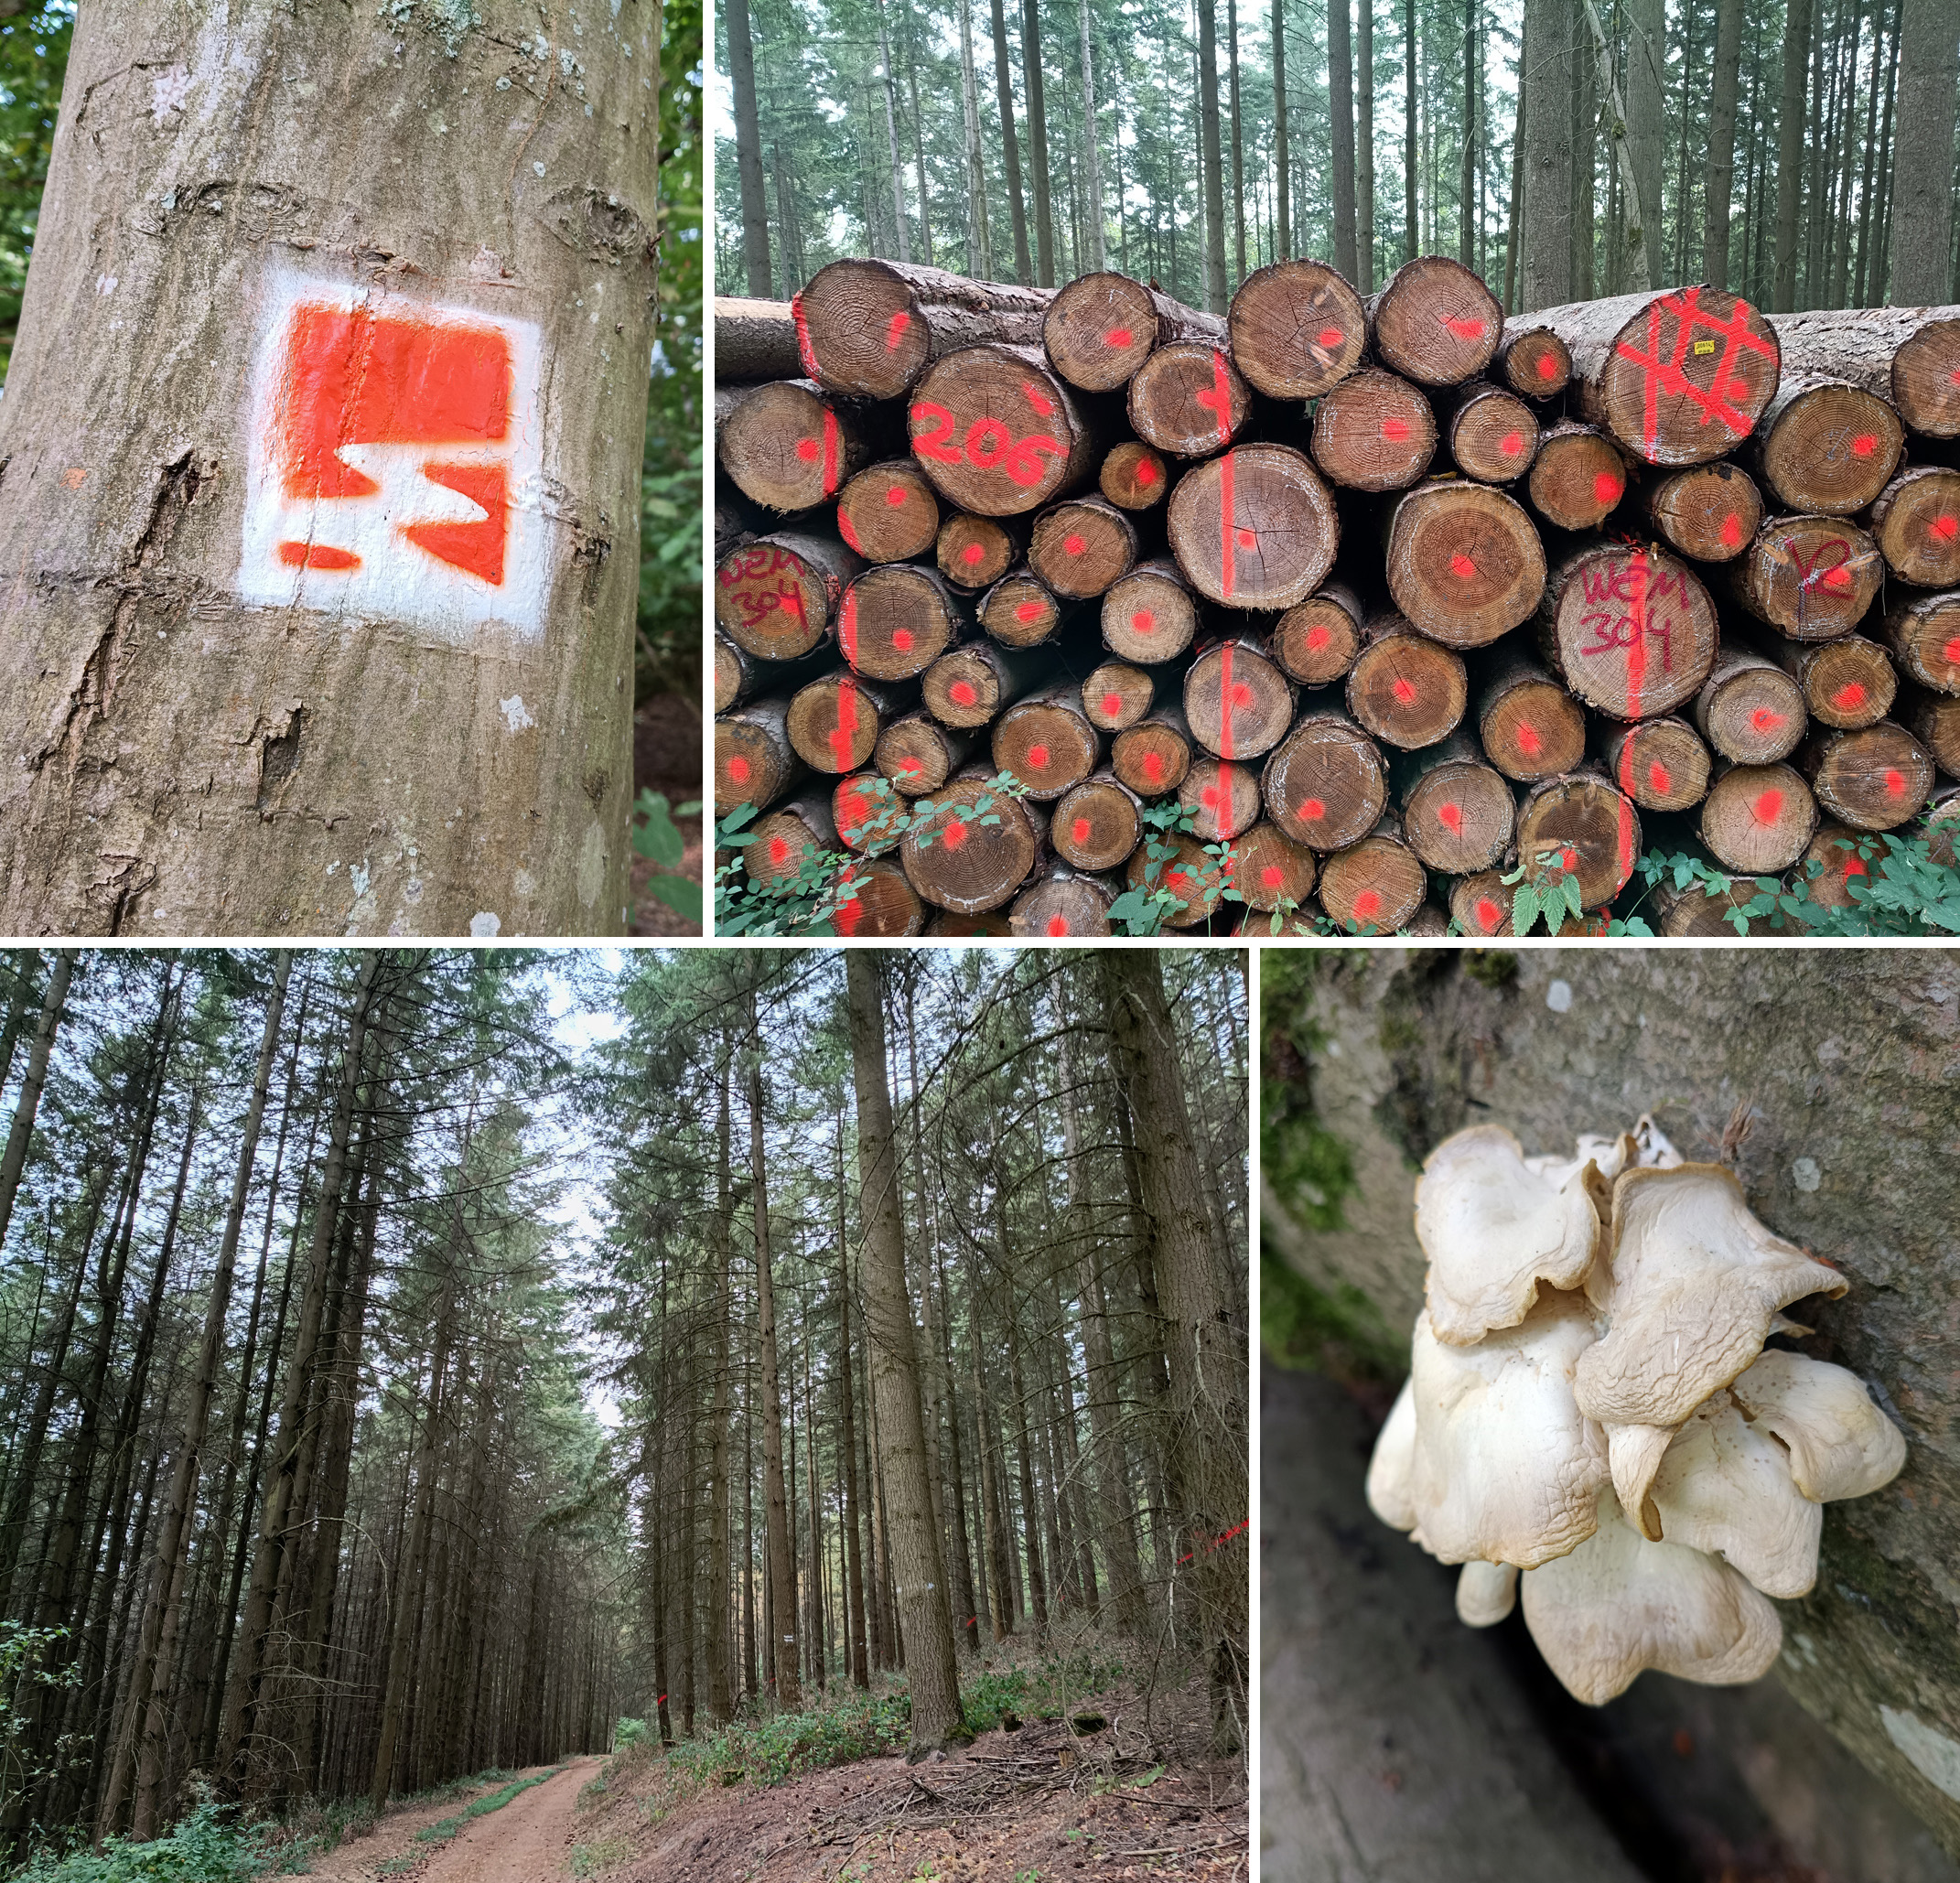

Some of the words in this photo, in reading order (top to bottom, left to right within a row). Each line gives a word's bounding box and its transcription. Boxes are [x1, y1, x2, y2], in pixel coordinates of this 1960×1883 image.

[910, 402, 1070, 488] 206
[731, 578, 810, 638] 304
[1580, 608, 1672, 672] 304
